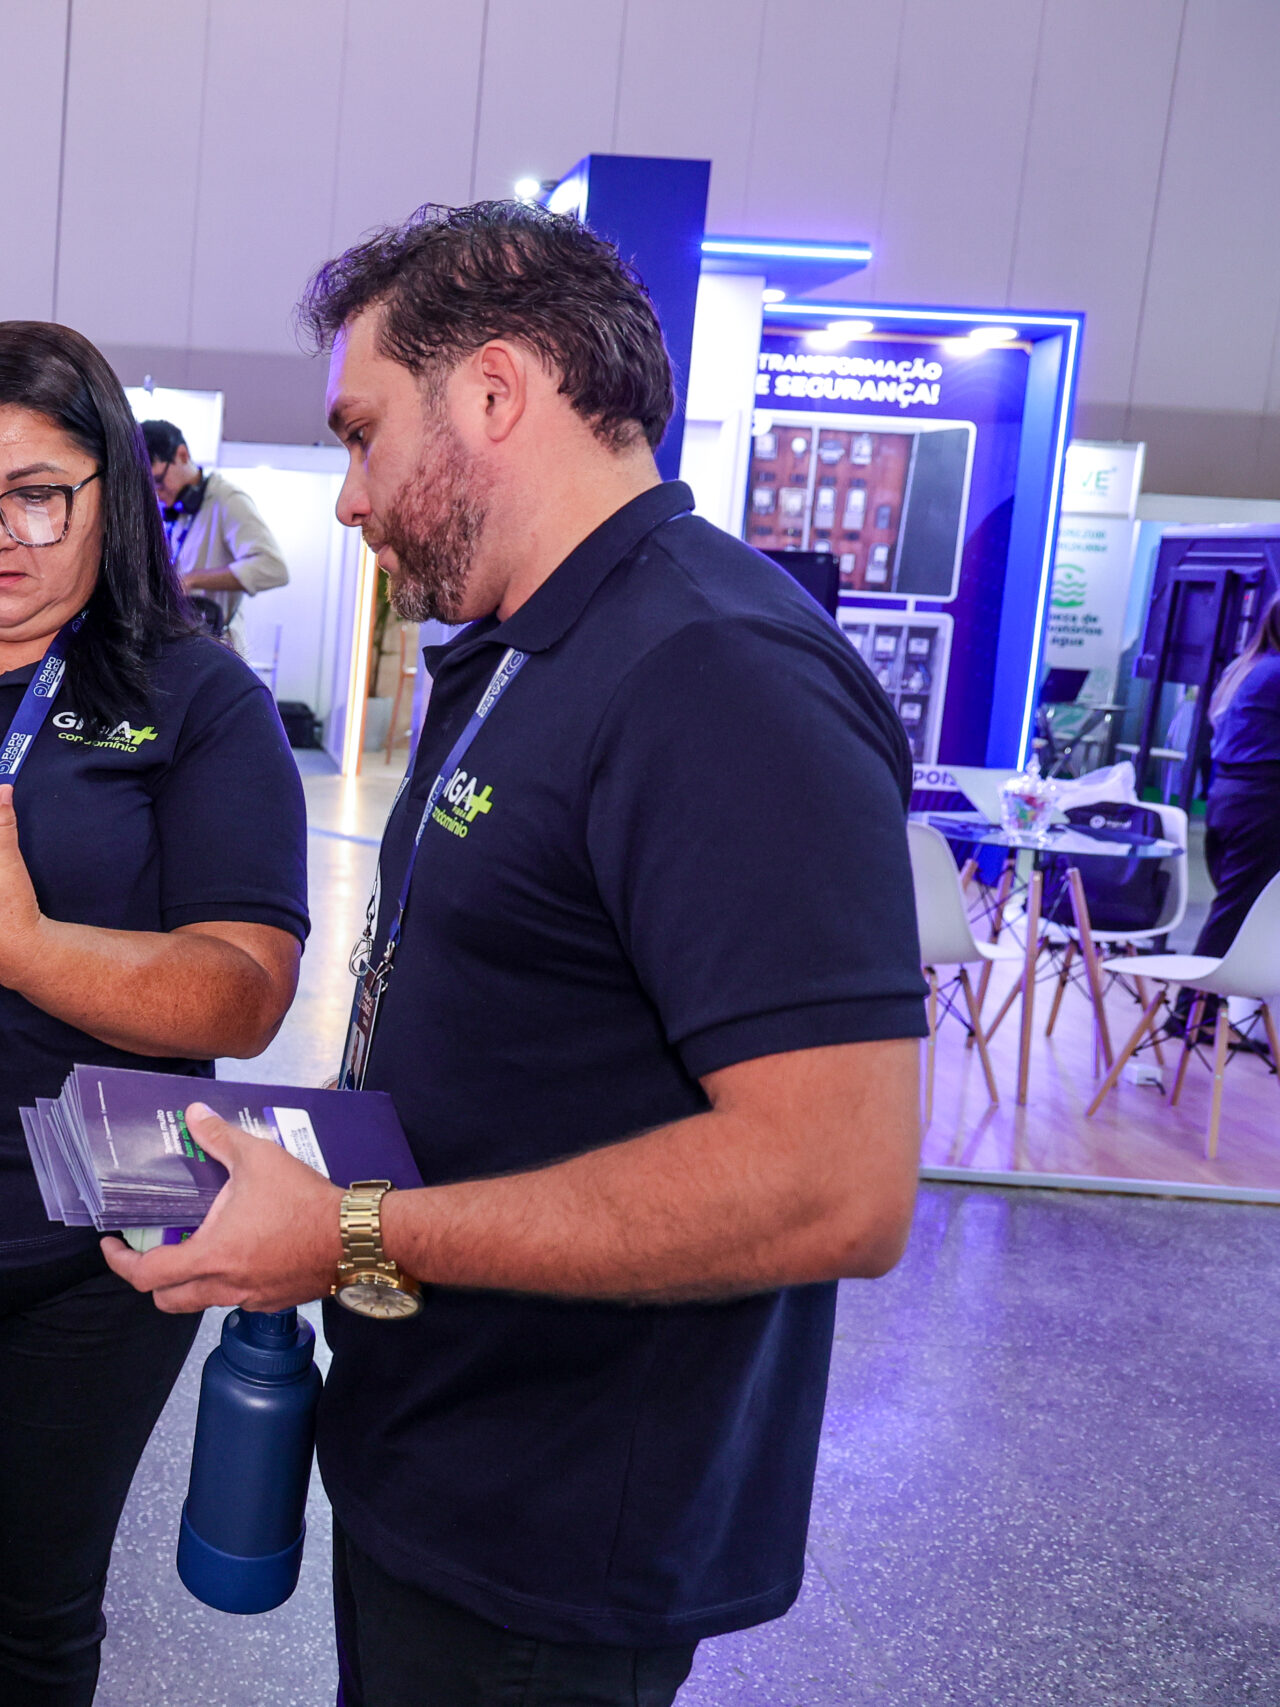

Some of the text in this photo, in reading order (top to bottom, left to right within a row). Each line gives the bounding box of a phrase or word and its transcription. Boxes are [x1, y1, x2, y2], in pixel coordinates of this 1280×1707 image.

[759, 353, 943, 383] TRANSFORMAÇÃO
[774, 374, 941, 408] SEGURANÇA!
[39, 656, 57, 683] PAPO
[47, 658, 62, 684] CONDO
[1, 732, 20, 760] PAPO
[9, 733, 26, 760] CONDO
